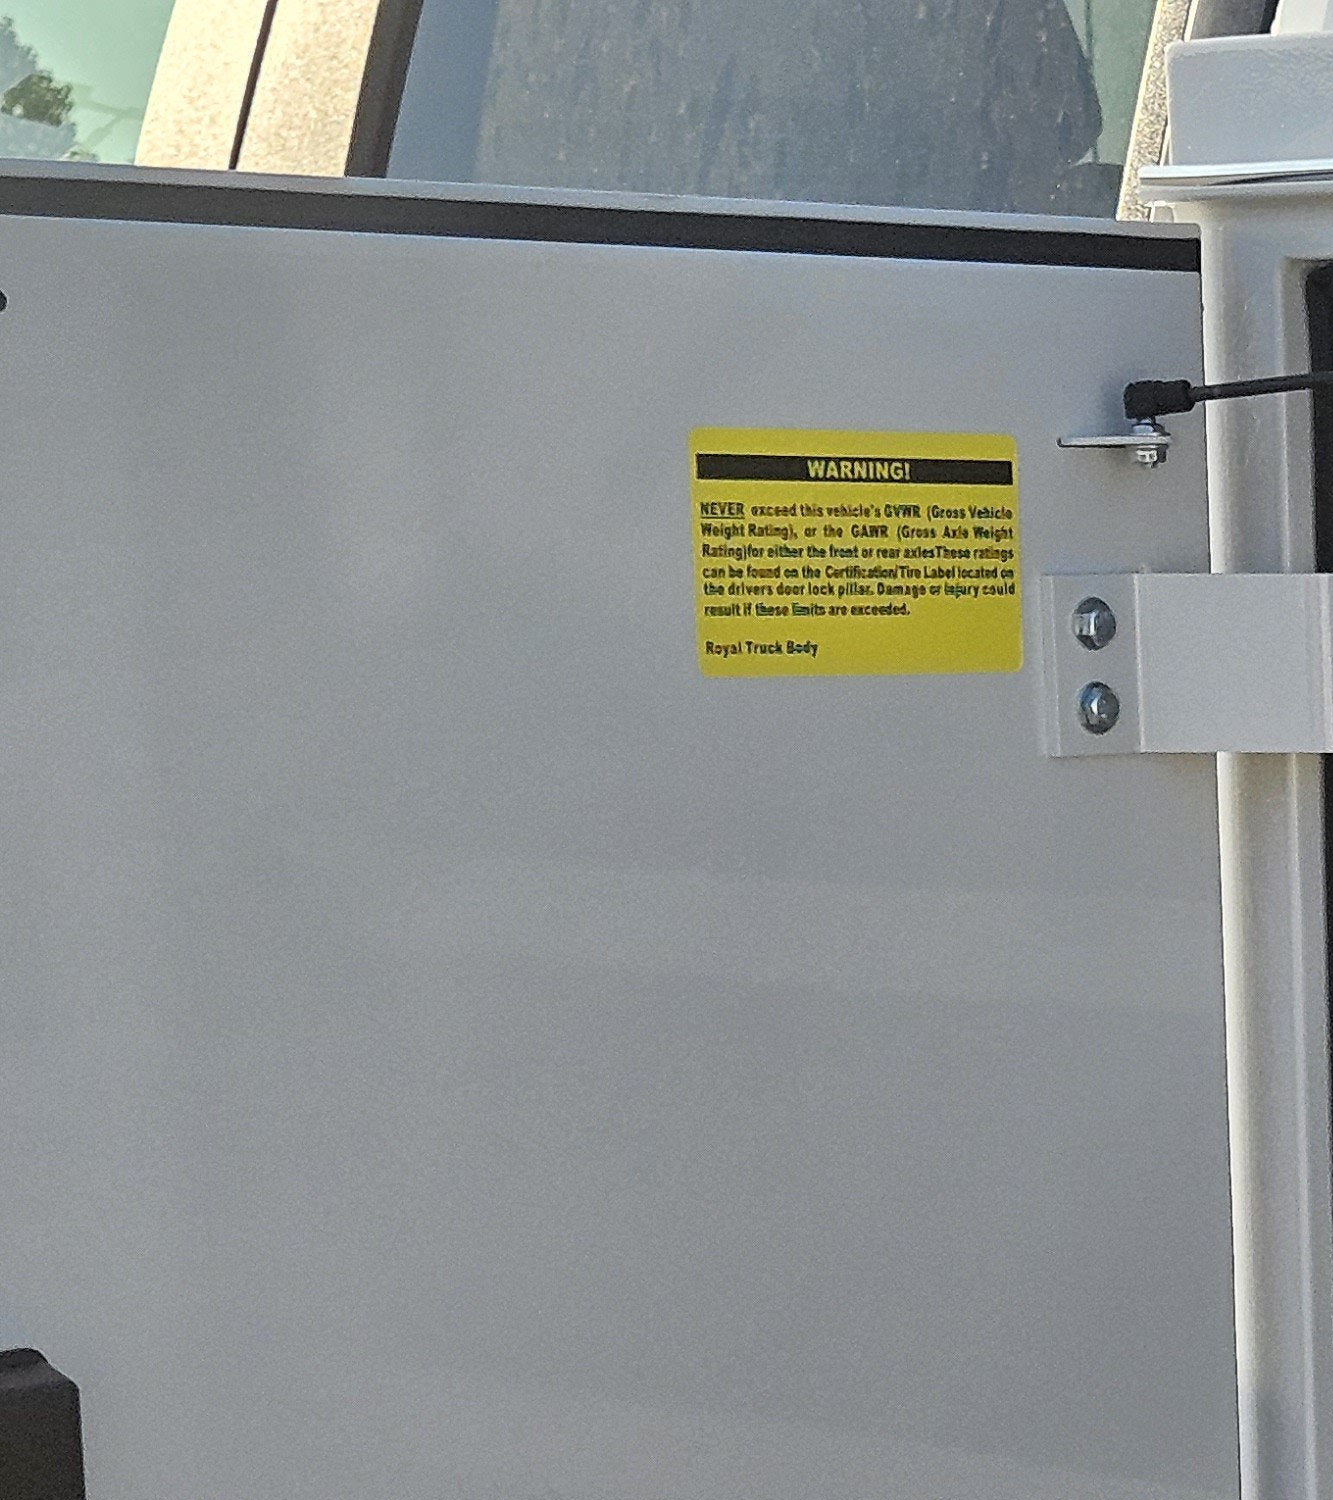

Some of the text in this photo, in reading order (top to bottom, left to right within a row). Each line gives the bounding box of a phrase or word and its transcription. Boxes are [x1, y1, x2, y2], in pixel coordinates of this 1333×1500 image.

[806, 459, 911, 481] WARNING!
[700, 501, 1012, 521] NEVER exceed this vehicle's GVWR (Gross Vehicle
[701, 523, 745, 540] Weight
[804, 527, 816, 538] or
[823, 525, 843, 538] the
[851, 524, 888, 538] GAWR
[897, 525, 936, 541] (Gross
[942, 525, 968, 539] Axle
[973, 526, 1013, 542] Weight
[767, 544, 803, 557] either
[807, 545, 827, 558] the
[830, 544, 859, 558] front
[862, 548, 872, 558] or
[876, 548, 899, 558] rear
[974, 547, 1014, 562] ratings
[703, 567, 725, 578] can
[729, 565, 743, 578] be
[747, 565, 781, 578] found
[784, 568, 798, 578] on
[802, 565, 821, 578] the
[924, 566, 955, 579] Label
[958, 566, 998, 579] located
[1001, 568, 1014, 579] on
[704, 582, 725, 595] the
[728, 582, 773, 595] drivers
[776, 582, 804, 595] door
[808, 582, 835, 595] lock
[877, 582, 926, 598] Damage
[930, 585, 941, 595] or
[944, 583, 979, 598] injury
[983, 582, 1015, 595] could
[704, 602, 910, 616] result if these limits are exceeded.
[705, 640, 819, 658] Royal Truck Body
